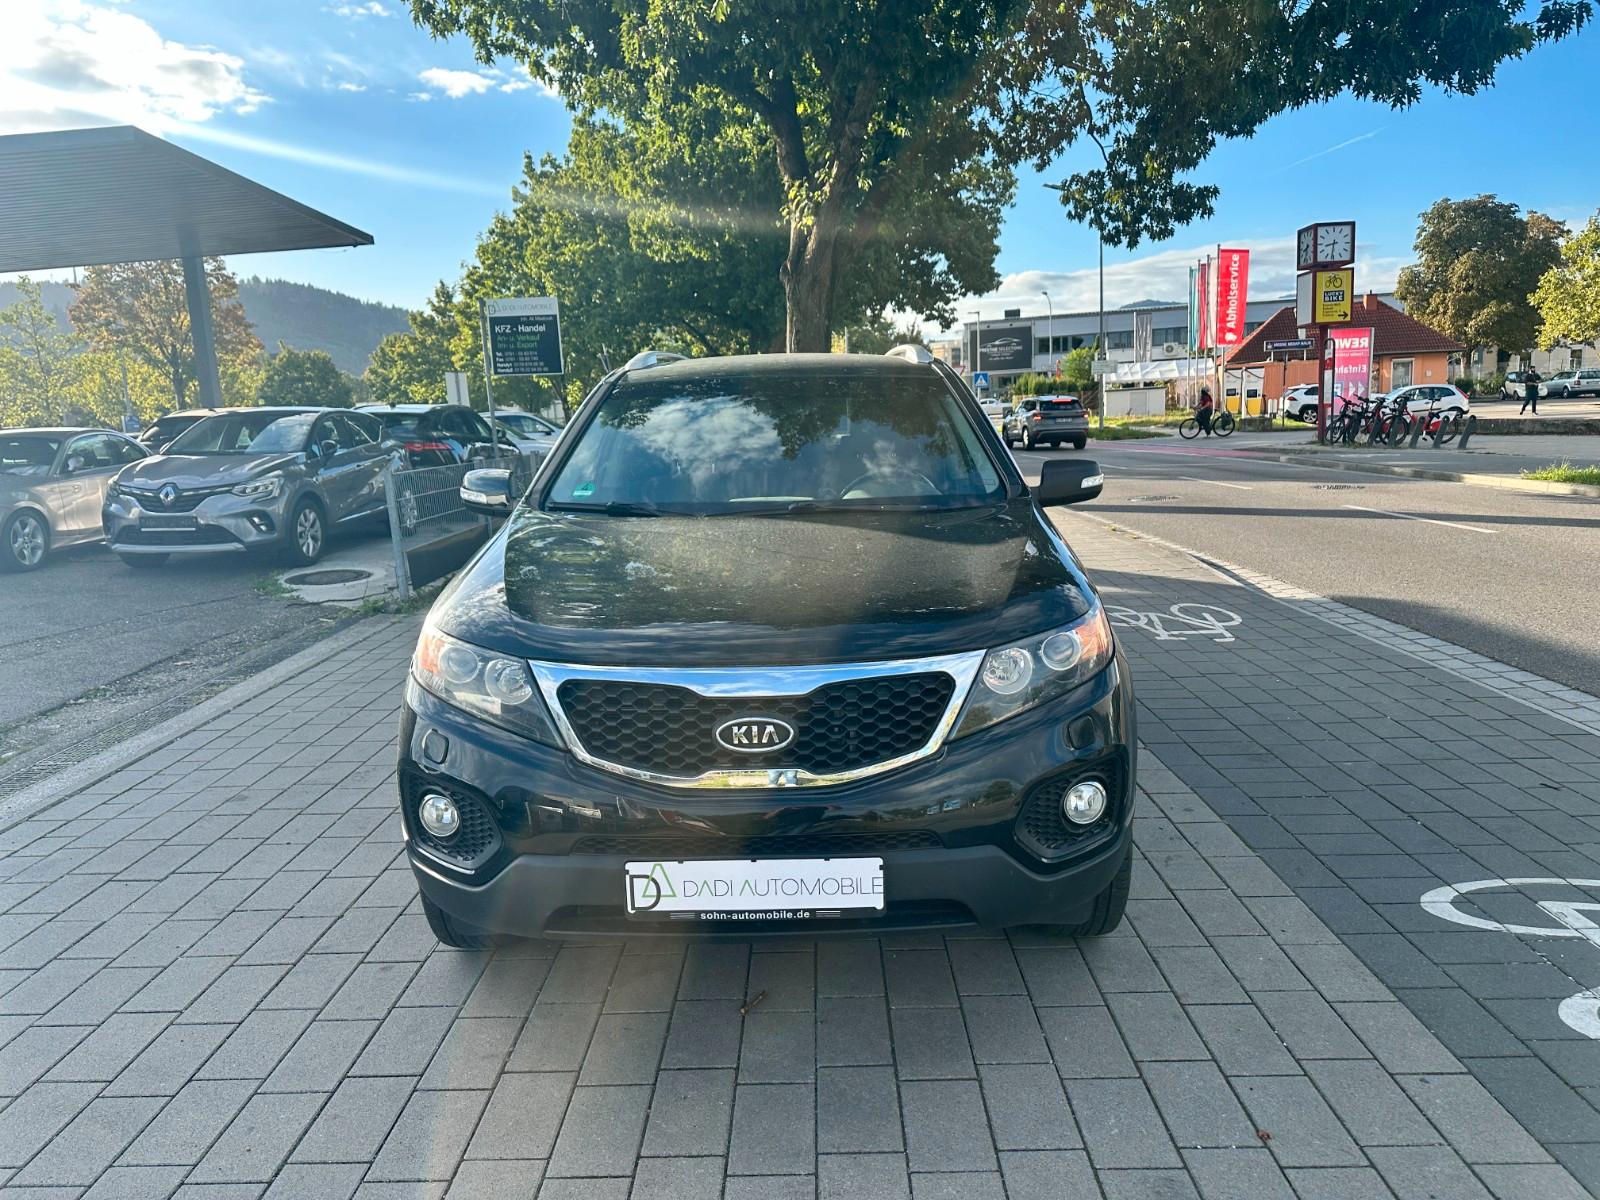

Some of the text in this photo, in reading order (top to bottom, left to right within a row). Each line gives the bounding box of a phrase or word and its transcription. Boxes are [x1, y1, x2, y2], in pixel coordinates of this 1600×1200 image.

[1226, 253, 1239, 328] Abholservice
[495, 325, 511, 333] KFZ
[518, 324, 546, 332] Handel
[732, 725, 779, 745] KIA
[683, 879, 733, 898] DADI
[740, 876, 884, 897] AUTOMOBILE
[700, 910, 810, 920] sohn-automobile.de
